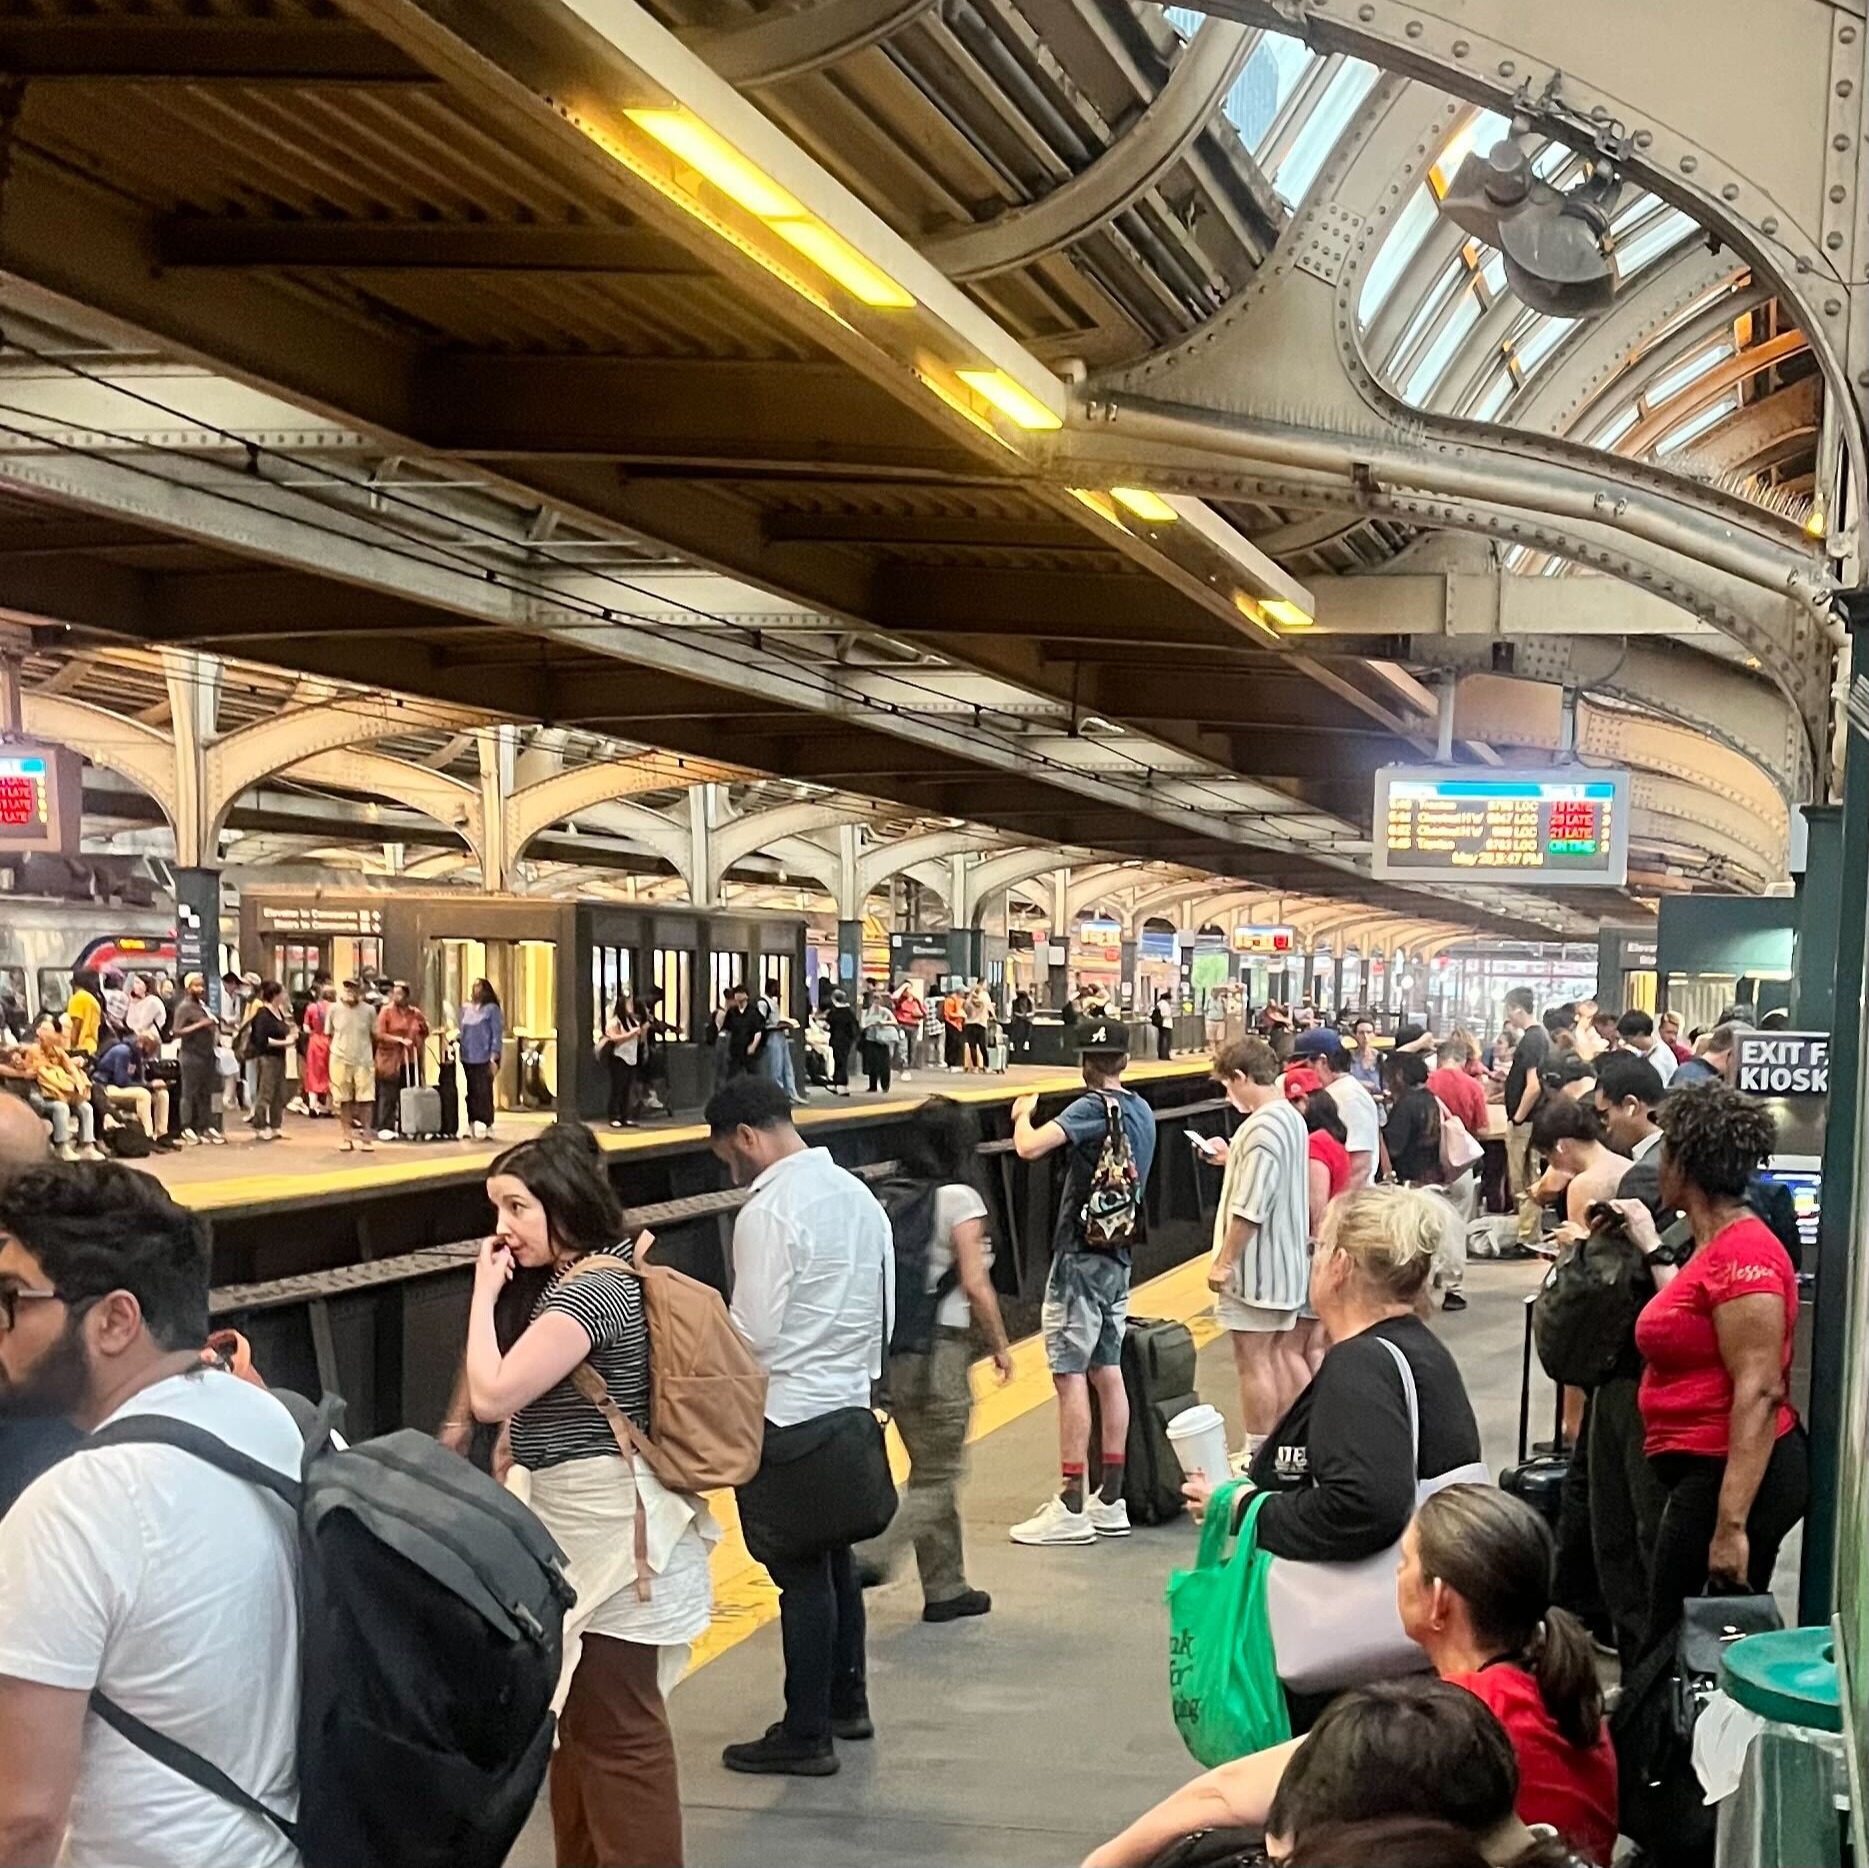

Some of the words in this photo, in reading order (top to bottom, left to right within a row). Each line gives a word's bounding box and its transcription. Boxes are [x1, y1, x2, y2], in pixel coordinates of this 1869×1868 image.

[1514, 814, 1538, 825] LOC
[1565, 815, 1592, 826] LATE
[1565, 827, 1592, 839] LATE
[1742, 1041, 1805, 1065] EXIT
[1741, 1067, 1829, 1092] KIOSK
